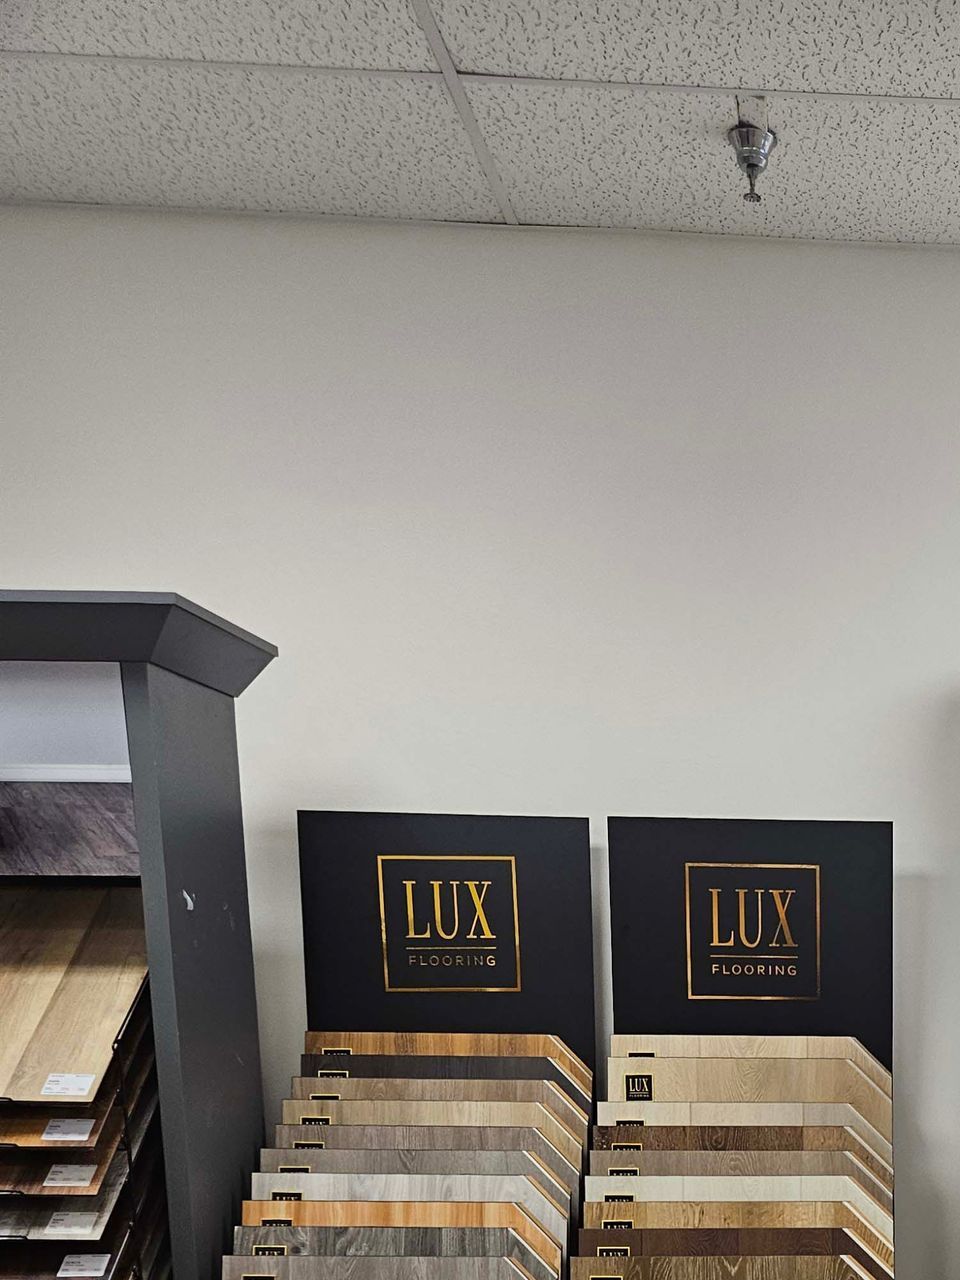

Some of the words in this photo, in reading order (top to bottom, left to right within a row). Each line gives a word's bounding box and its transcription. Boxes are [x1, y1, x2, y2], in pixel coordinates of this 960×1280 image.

[402, 880, 497, 940] LUX
[708, 888, 799, 948] LUX
[408, 955, 496, 967] FLOORING
[711, 963, 797, 977] FLOORING
[629, 1078, 649, 1092] LUX
